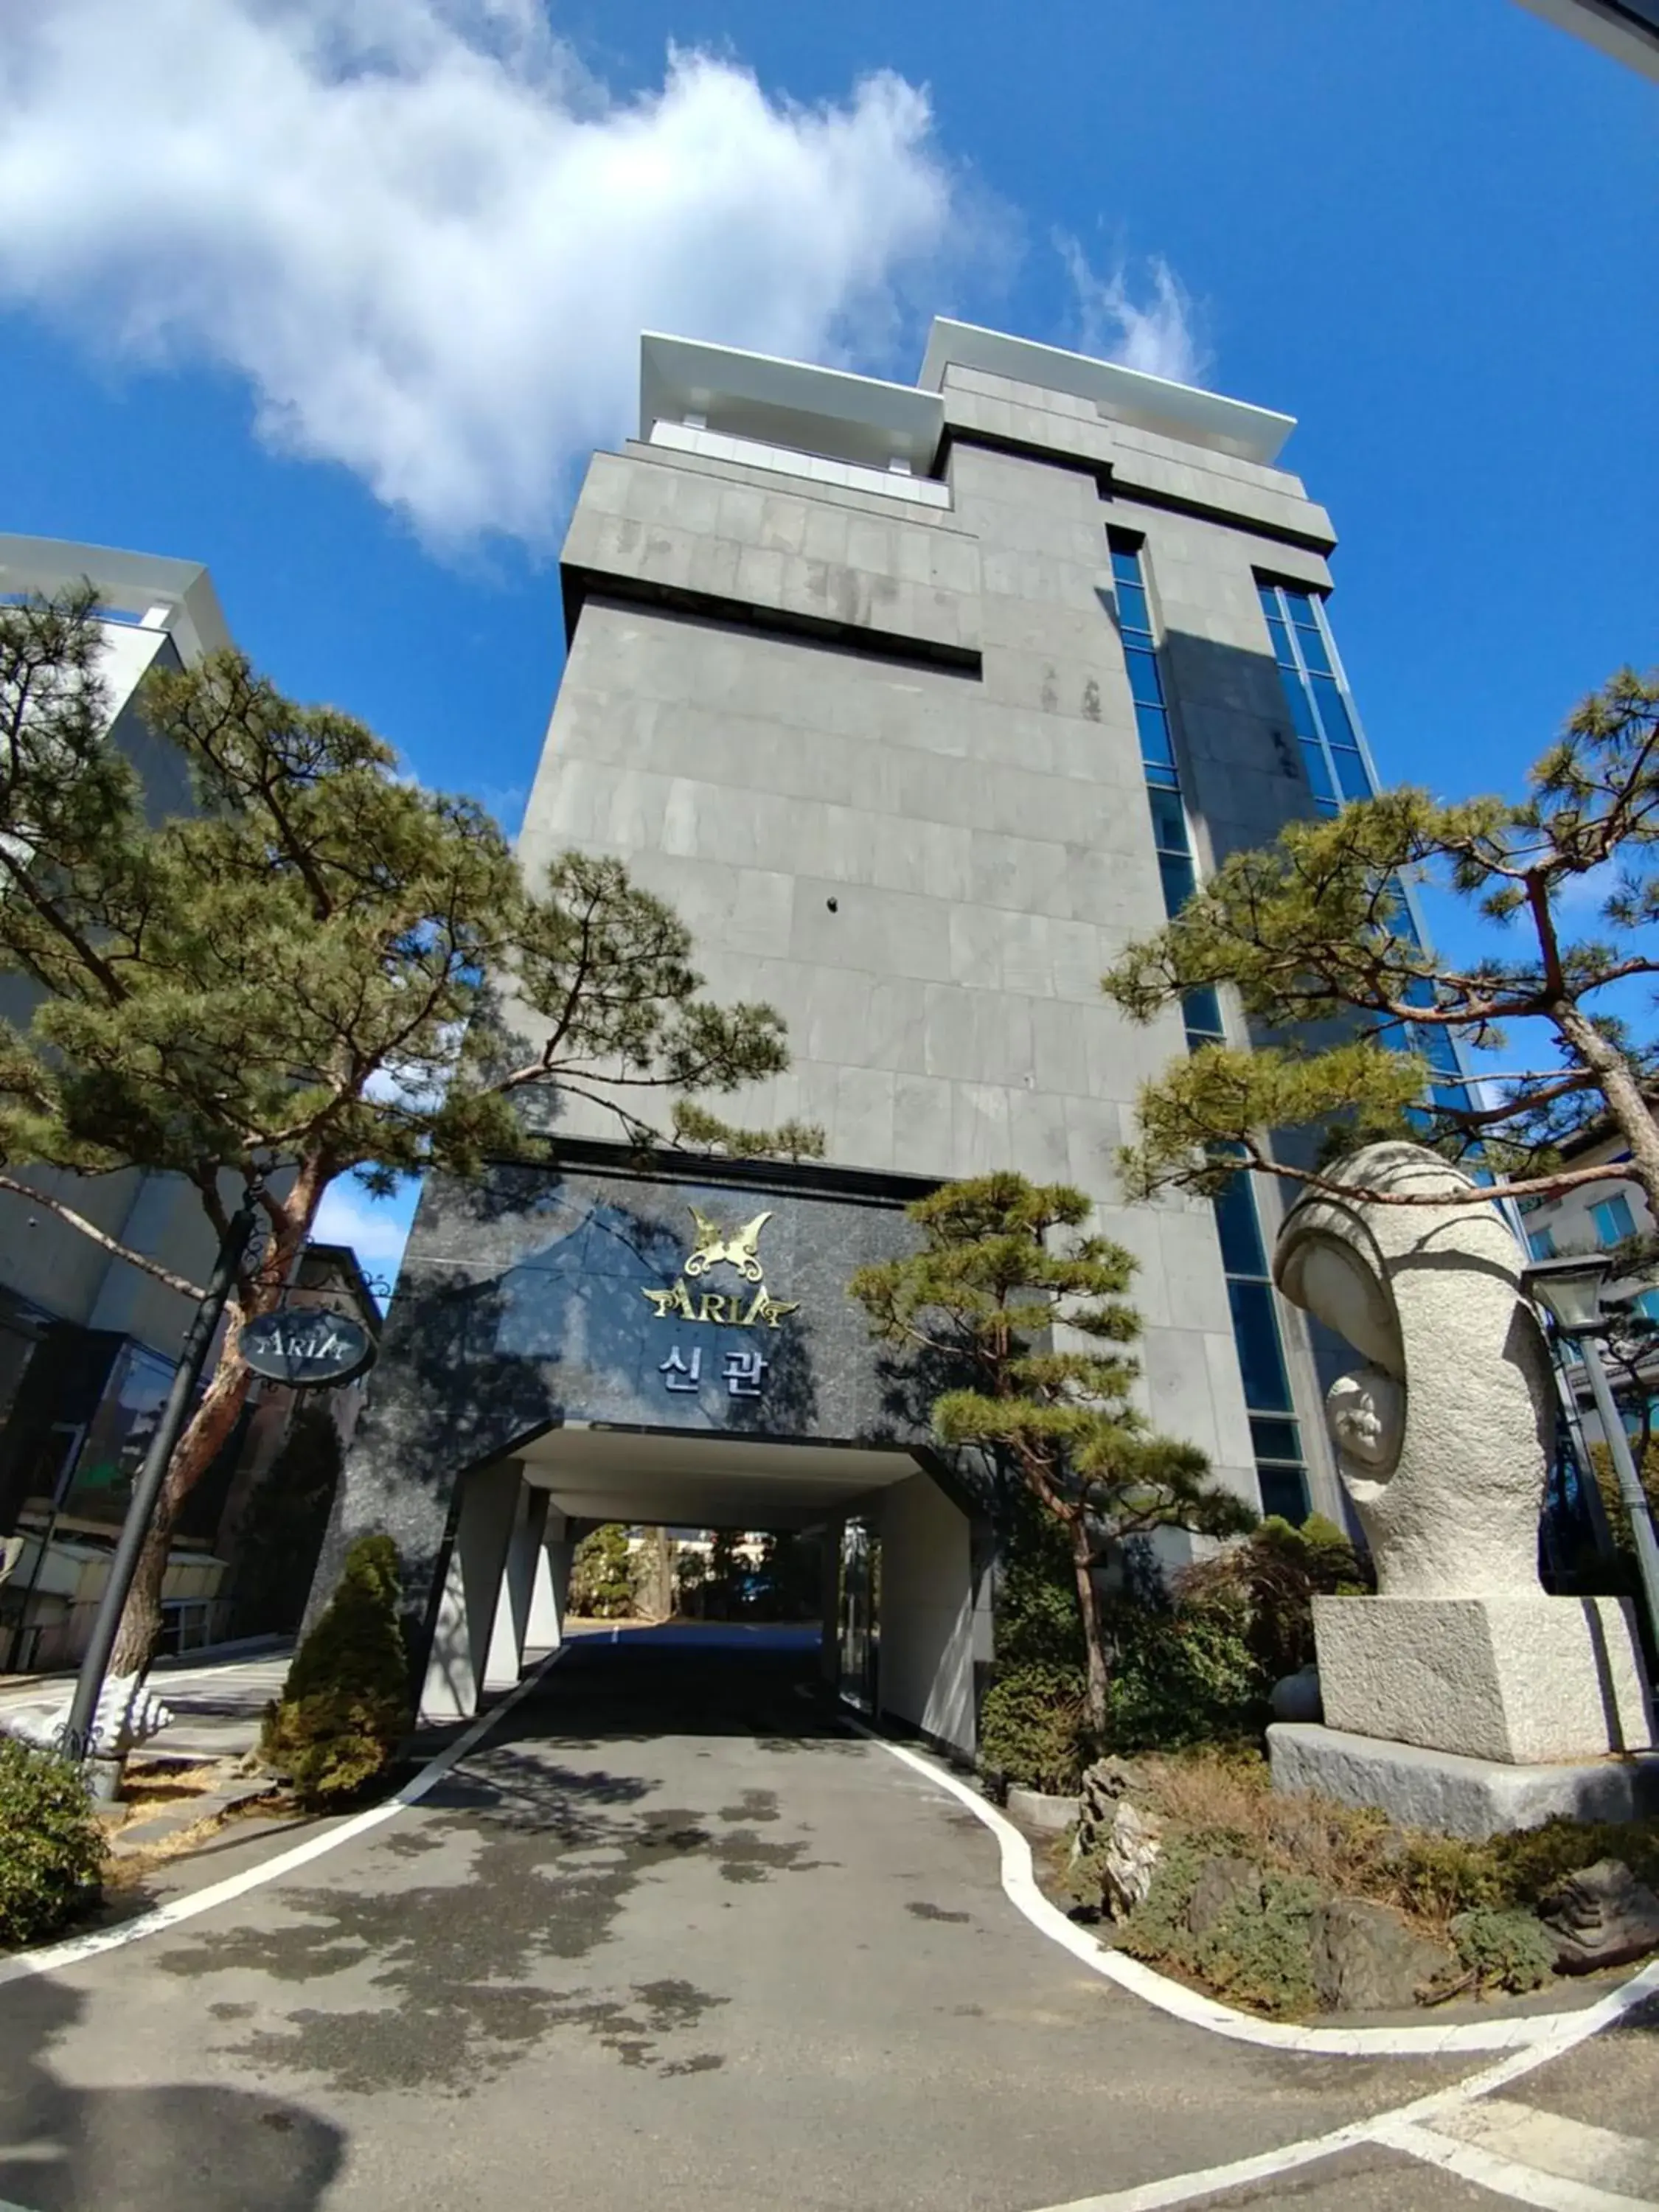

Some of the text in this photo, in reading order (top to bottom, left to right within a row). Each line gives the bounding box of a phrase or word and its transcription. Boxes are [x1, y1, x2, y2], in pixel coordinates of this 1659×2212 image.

[641, 1277, 800, 1327] ARIA
[252, 1328, 354, 1360] ARIA
[660, 1345, 768, 1395] 신관
